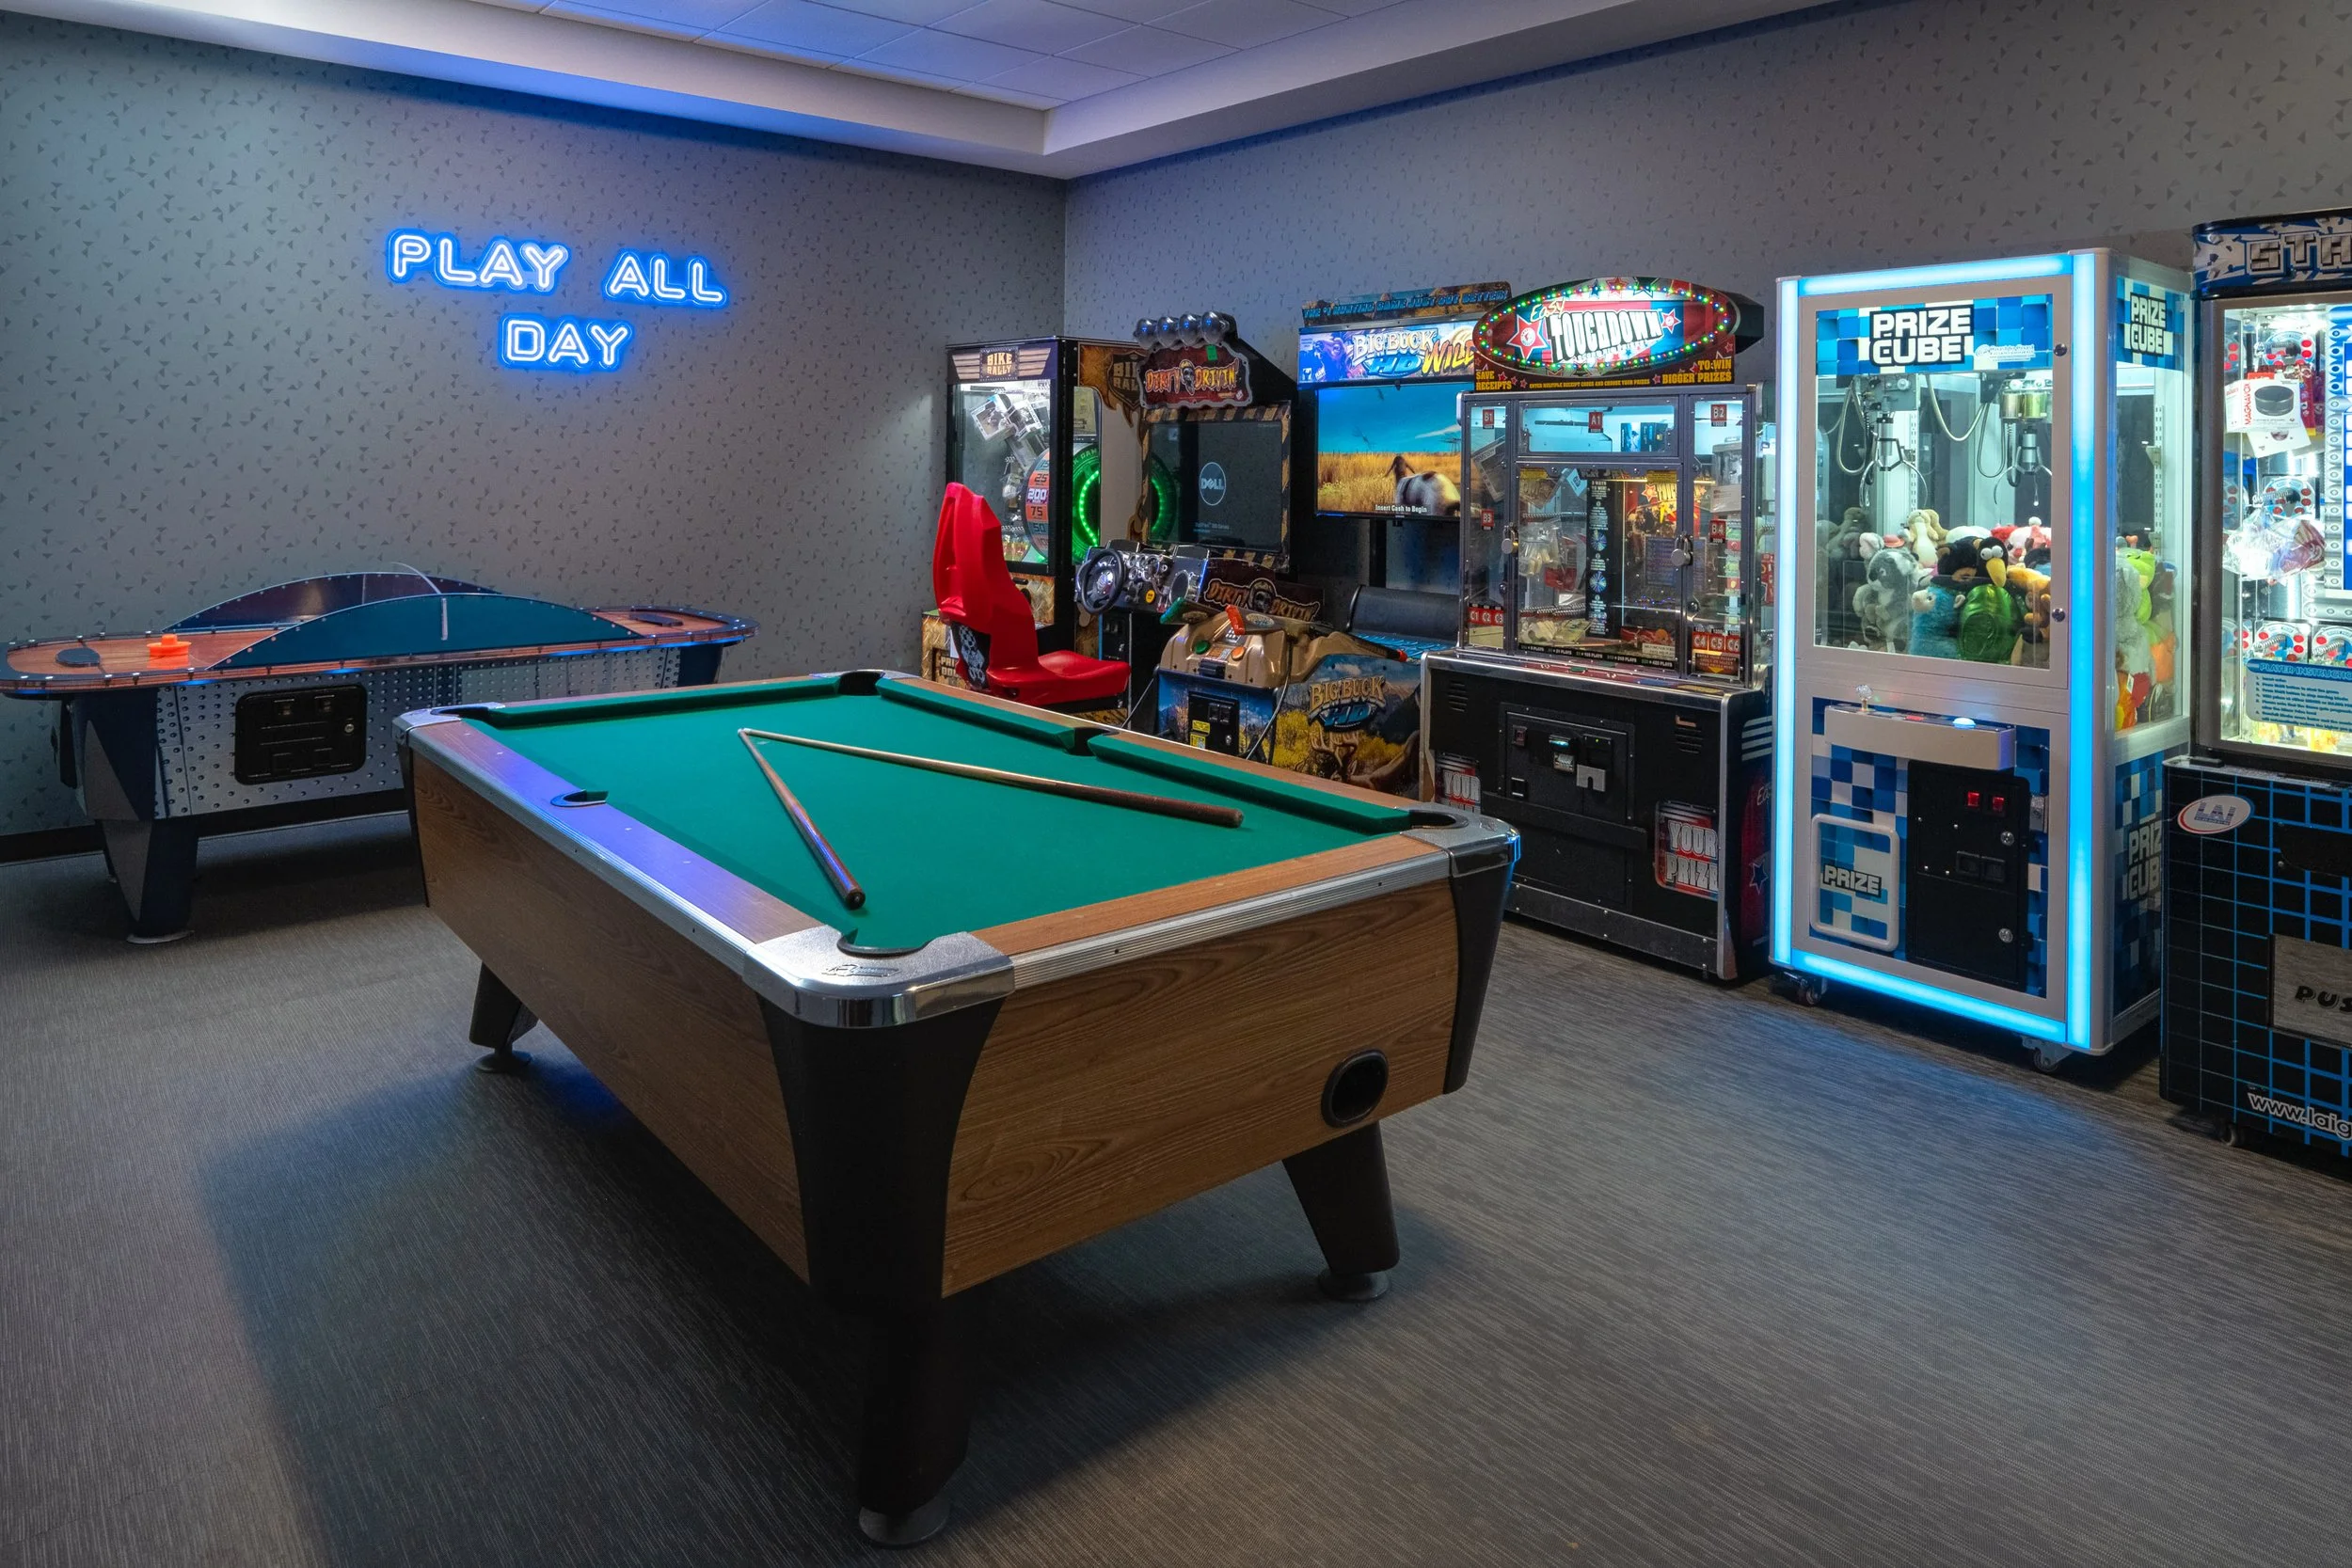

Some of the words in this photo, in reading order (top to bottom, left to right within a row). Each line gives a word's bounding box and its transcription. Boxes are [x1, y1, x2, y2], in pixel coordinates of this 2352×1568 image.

[392, 233, 566, 290] PLAY
[609, 255, 724, 303] ALL
[1376, 298, 1407, 310] GAME
[1409, 294, 1436, 308] JUST
[1530, 299, 1566, 322] Easy
[2130, 294, 2167, 326] PRIZE
[1871, 307, 1972, 340] PRIZE
[504, 318, 630, 367] DAY
[1549, 310, 1663, 361] TOUCHDOWN
[2130, 323, 2164, 355] CUBE
[1353, 333, 1383, 361] BIG
[1384, 329, 1438, 354] BUCK
[1871, 334, 1965, 365] CUBE
[986, 352, 1013, 365] BIKE
[1422, 340, 1475, 374] WILD
[986, 364, 1012, 375] RALLY
[1114, 362, 1137, 377] BI
[1368, 356, 1419, 374] HD
[1697, 361, 1710, 371] TO
[1713, 359, 1732, 370] WIN
[1145, 367, 1180, 394] DIRTY
[1476, 371, 1495, 380] SAVE
[1661, 373, 1695, 385] BIGGER
[1696, 372, 1732, 383] PRIZES
[1114, 377, 1139, 391] RAL
[1476, 381, 1512, 390] RECEIPTS
[2243, 383, 2252, 425] MAGNAVOX
[1484, 413, 1493, 422] B1
[1713, 406, 1724, 419] B2
[1590, 416, 1601, 426] A1
[1034, 473, 1049, 483] 25
[1200, 478, 1224, 490] DELL
[1027, 489, 1047, 500] 200
[1030, 506, 1043, 516] 75
[1411, 506, 1428, 515] Begin
[1711, 524, 1724, 534] B4
[1470, 611, 1479, 622] C1
[1482, 612, 1491, 622] C2
[1494, 613, 1503, 623] C3
[1693, 634, 1706, 646] C4
[1710, 637, 1723, 649] C5
[1727, 639, 1740, 651] C6
[941, 657, 955, 667] PRI
[2259, 662, 2295, 674] PLAYER
[1310, 683, 1339, 711] BIG
[1341, 675, 1386, 705] BUCK
[1443, 768, 1481, 801] YOUR
[1756, 783, 1772, 806] Ea
[1667, 819, 1719, 860] YOUR
[2128, 820, 2162, 867] PRIZ
[1664, 850, 1719, 893] PRIZE
[1824, 864, 1882, 895] PRIZE
[2127, 857, 2161, 901] CUB
[2247, 1092, 2352, 1141] www.laig
